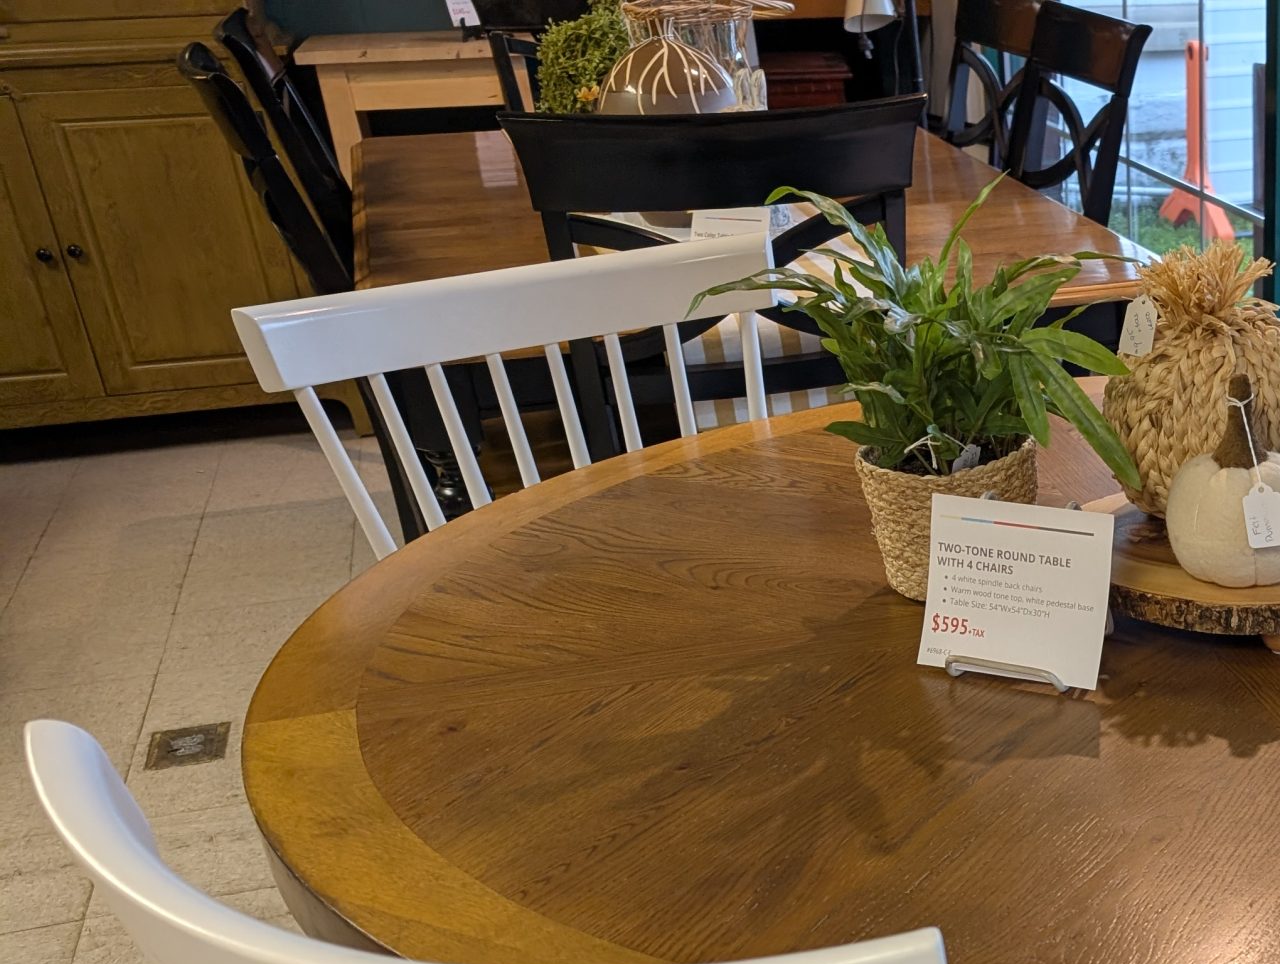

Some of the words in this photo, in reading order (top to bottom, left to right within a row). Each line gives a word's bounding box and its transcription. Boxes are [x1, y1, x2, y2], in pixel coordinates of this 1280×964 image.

[938, 542, 994, 558] TWO-TONE
[997, 550, 1036, 563] ROUND
[1039, 555, 1072, 568] TABLE
[937, 556, 964, 568] WITH
[966, 560, 973, 570] 4
[975, 561, 1014, 575] CHAIRS
[951, 574, 957, 582] 4
[957, 575, 977, 585] white
[978, 577, 1003, 588] spindle
[1004, 580, 1021, 590] back
[1021, 583, 1043, 593] chairs
[950, 597, 969, 608] Table
[971, 600, 988, 610] Size:
[951, 585, 972, 595] Warm
[973, 588, 992, 598] wood
[993, 591, 1010, 600] tone
[1025, 595, 1045, 605] white
[1046, 598, 1076, 610] pedestal
[1077, 603, 1095, 613] base
